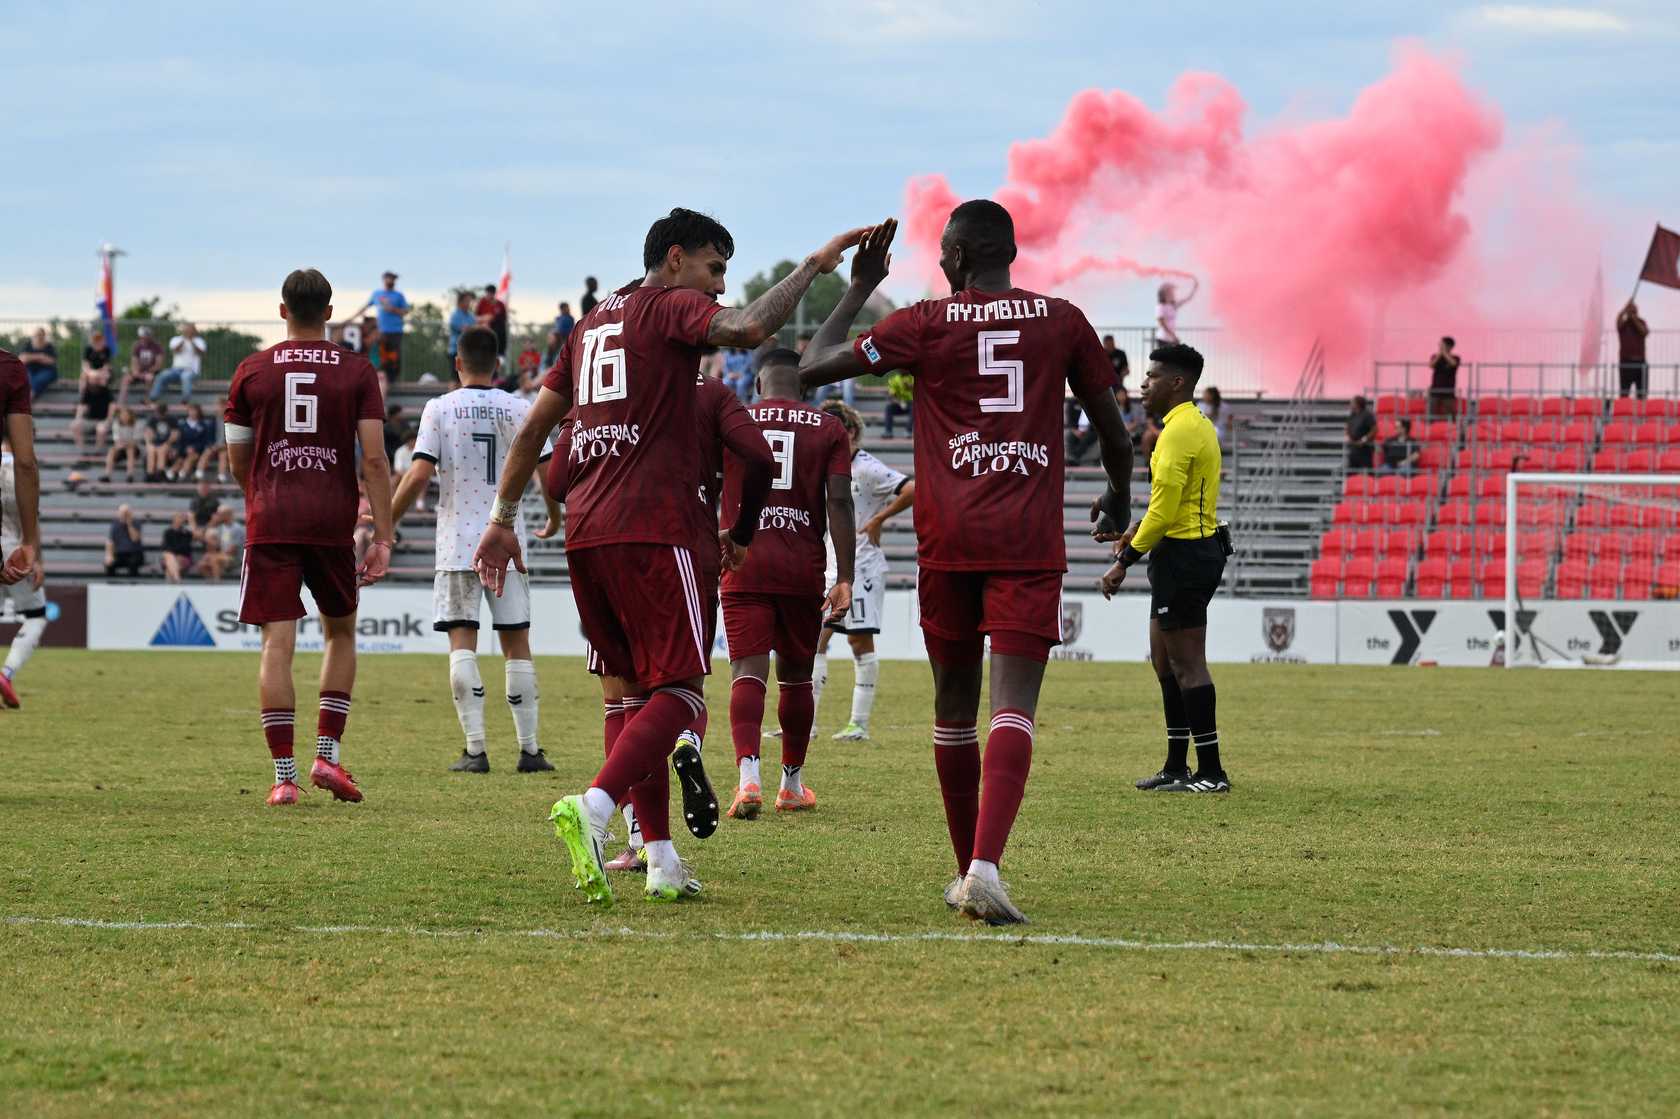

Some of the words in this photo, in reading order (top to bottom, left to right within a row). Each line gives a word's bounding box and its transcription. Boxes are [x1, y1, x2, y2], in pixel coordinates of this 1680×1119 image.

[947, 299, 1048, 322] AYIMBILA
[273, 349, 340, 365] WESSELS
[578, 321, 627, 406] 16
[978, 330, 1024, 413] 5
[285, 372, 318, 433] 6
[747, 407, 784, 422] LEFI
[788, 409, 822, 426] REIS
[569, 423, 640, 455] ARNICERIAS
[949, 431, 980, 449] SÚPER
[270, 446, 337, 468] CARNICERIAS
[285, 456, 327, 472] LOA
[471, 433, 497, 485] 7
[951, 441, 1049, 470] CARNICERIAS
[971, 455, 1030, 477] LOA
[758, 515, 798, 532] LOA
[1366, 636, 1390, 650] the
[1466, 636, 1489, 650] the
[1567, 636, 1591, 650] the
